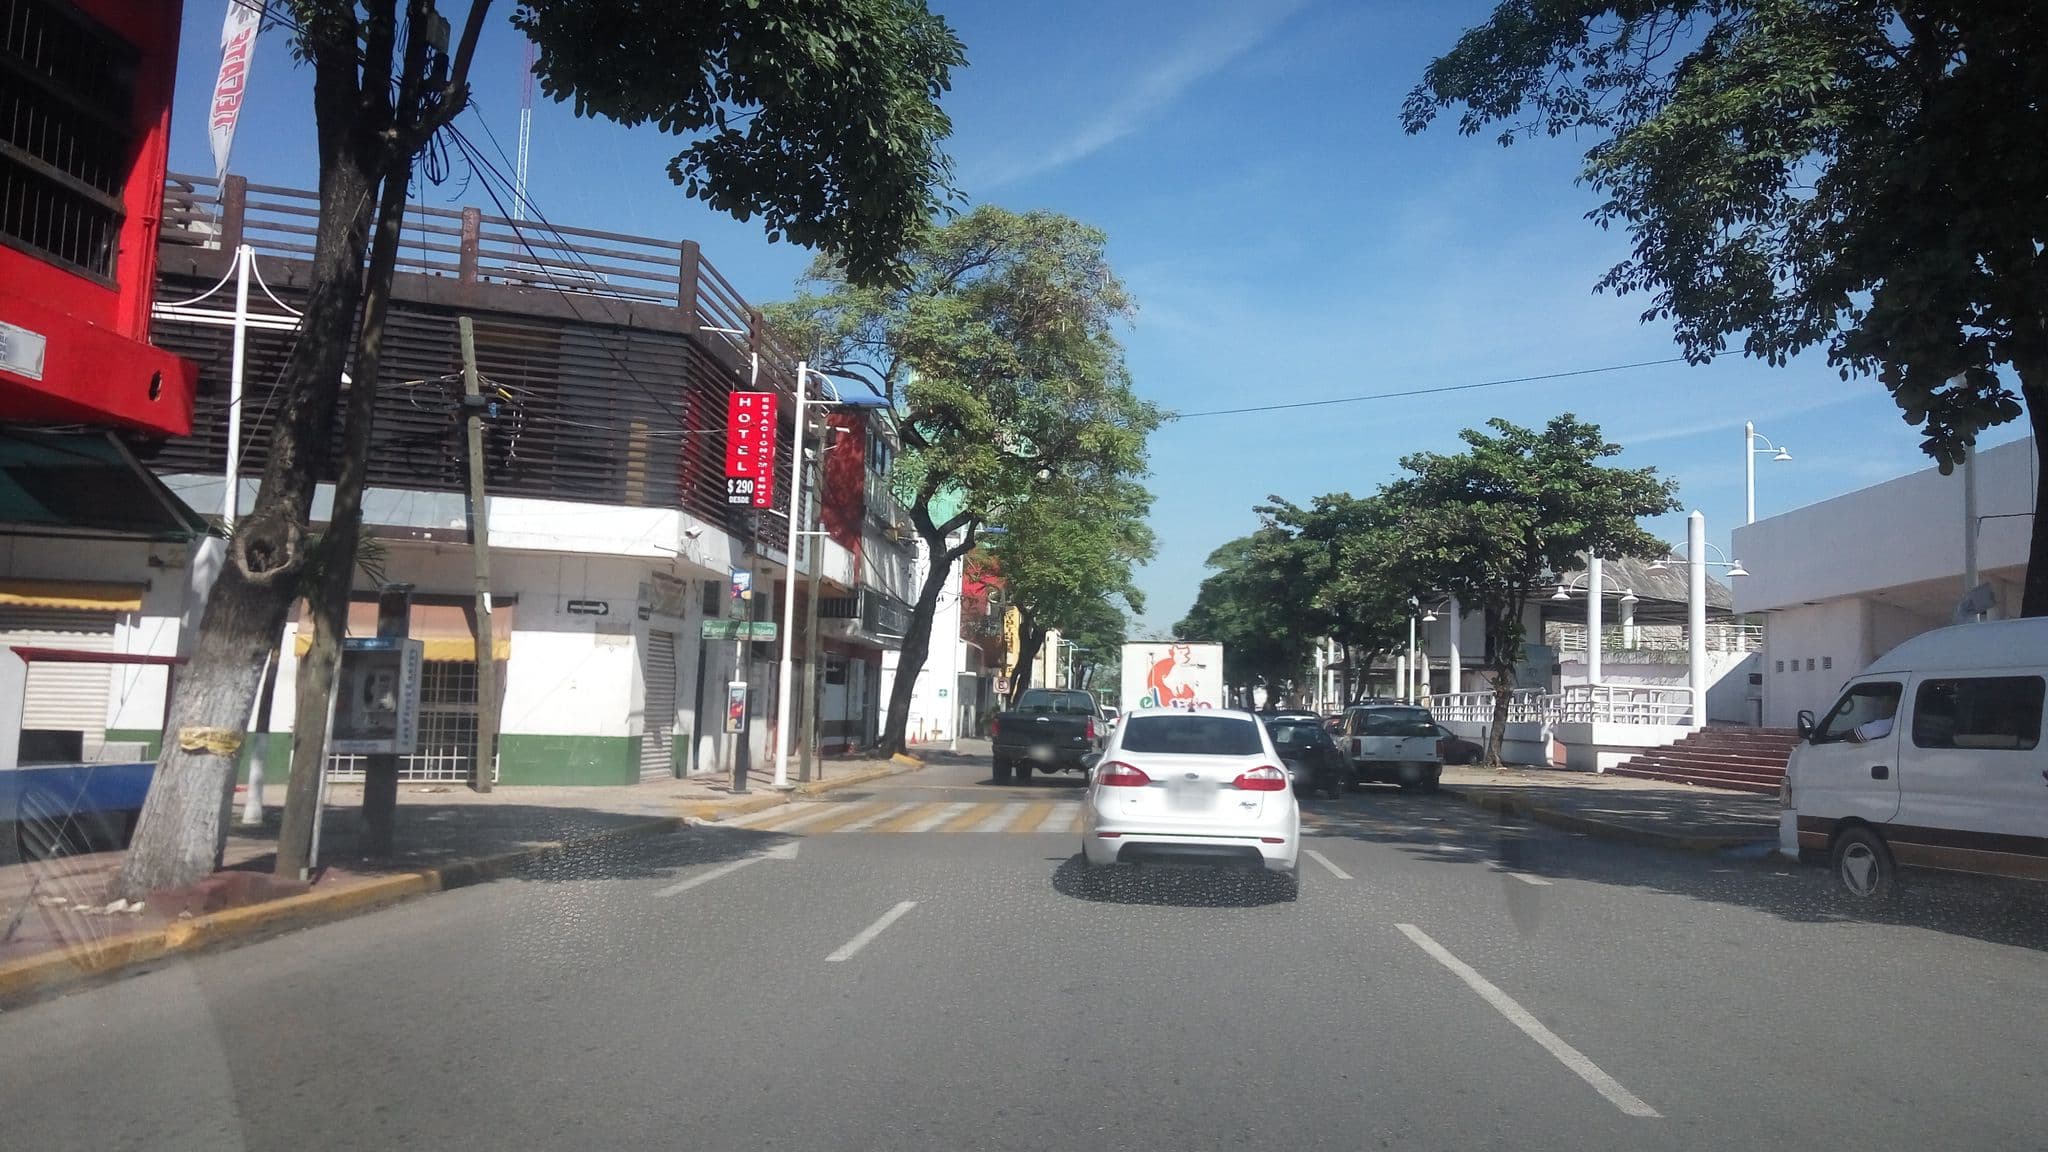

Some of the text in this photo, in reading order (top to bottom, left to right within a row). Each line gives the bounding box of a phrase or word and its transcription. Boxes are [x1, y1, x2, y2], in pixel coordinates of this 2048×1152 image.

[737, 397, 752, 472] HOTEL
[735, 479, 754, 494] 290
[728, 496, 750, 504] DESDE
